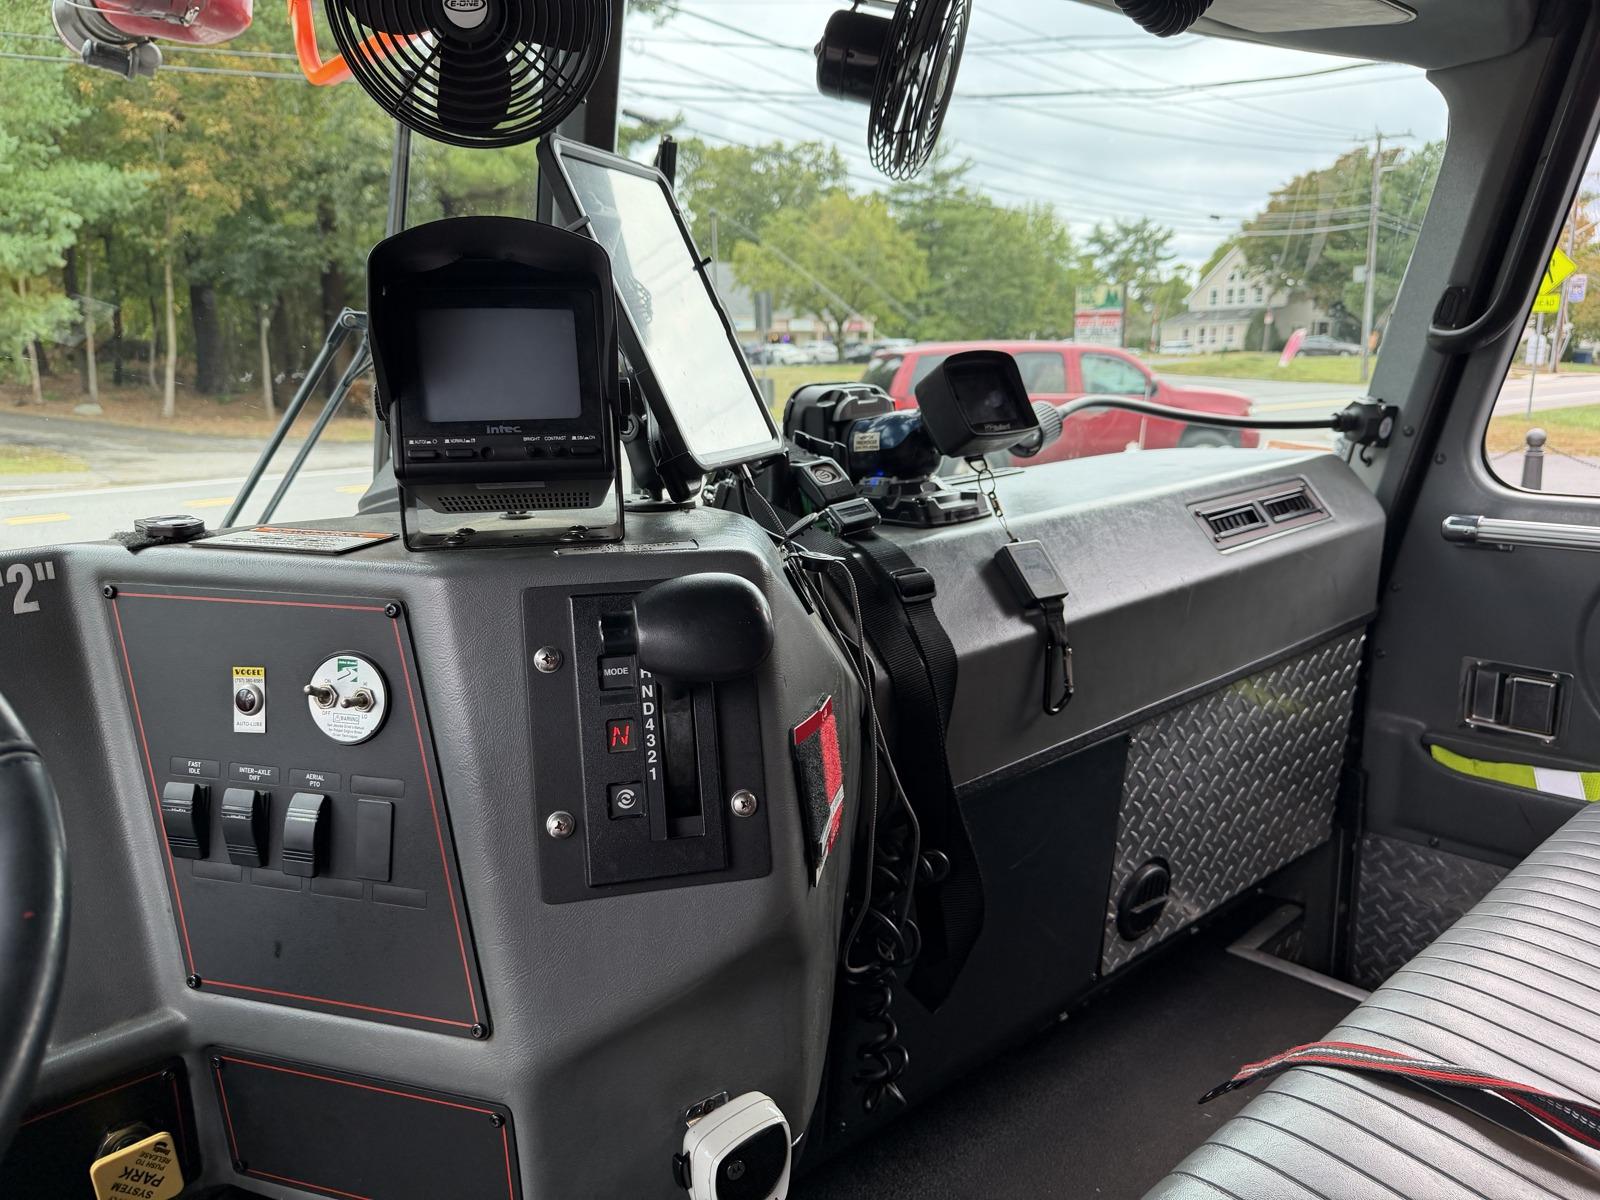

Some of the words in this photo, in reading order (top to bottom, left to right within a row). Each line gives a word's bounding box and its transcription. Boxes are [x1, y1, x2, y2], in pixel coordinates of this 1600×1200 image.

[234, 668, 262, 676] VOGEL
[603, 667, 629, 677] MODE
[611, 725, 630, 747] N
[187, 760, 201, 768] FAST
[188, 767, 201, 775] IDLE
[239, 766, 272, 777] INTER-AXLE
[305, 773, 325, 782] AERIAL
[309, 780, 321, 788] PTO
[139, 1150, 172, 1164] RELEASE
[135, 1158, 145, 1166] TO
[146, 1162, 166, 1171] PUSH
[118, 1166, 165, 1187] PARK
[111, 1182, 154, 1199] SYSTEM
